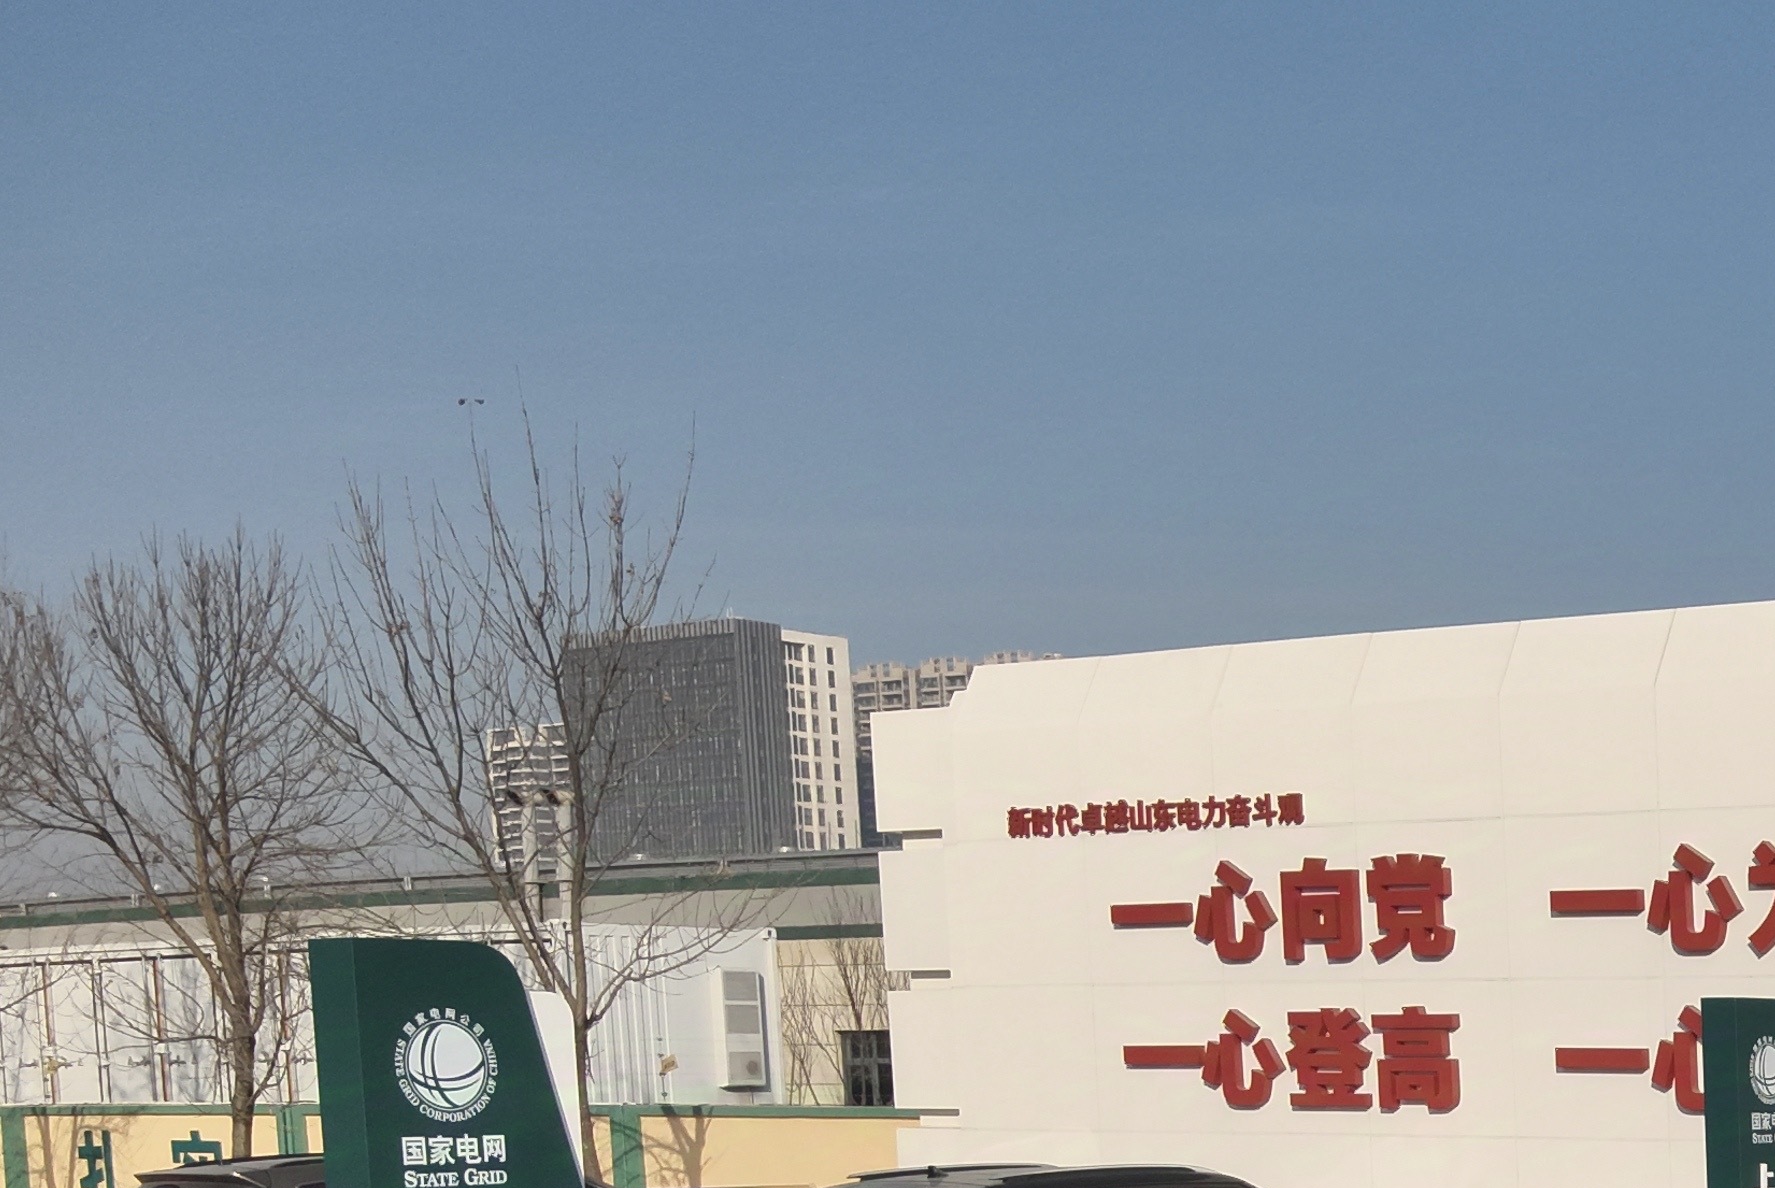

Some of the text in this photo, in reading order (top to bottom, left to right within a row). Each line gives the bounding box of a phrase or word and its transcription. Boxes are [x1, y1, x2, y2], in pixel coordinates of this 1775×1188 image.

[1007, 792, 1305, 838] 新时代卓越山东电力奋斗观
[1110, 853, 1456, 965] 一心向党
[394, 1038, 499, 1123] STATE GRID CORPORATION OF CHINA
[1123, 1005, 1461, 1114] 一心登高
[401, 1133, 507, 1166] 国家电网
[404, 1168, 508, 1188] STATE GRID
